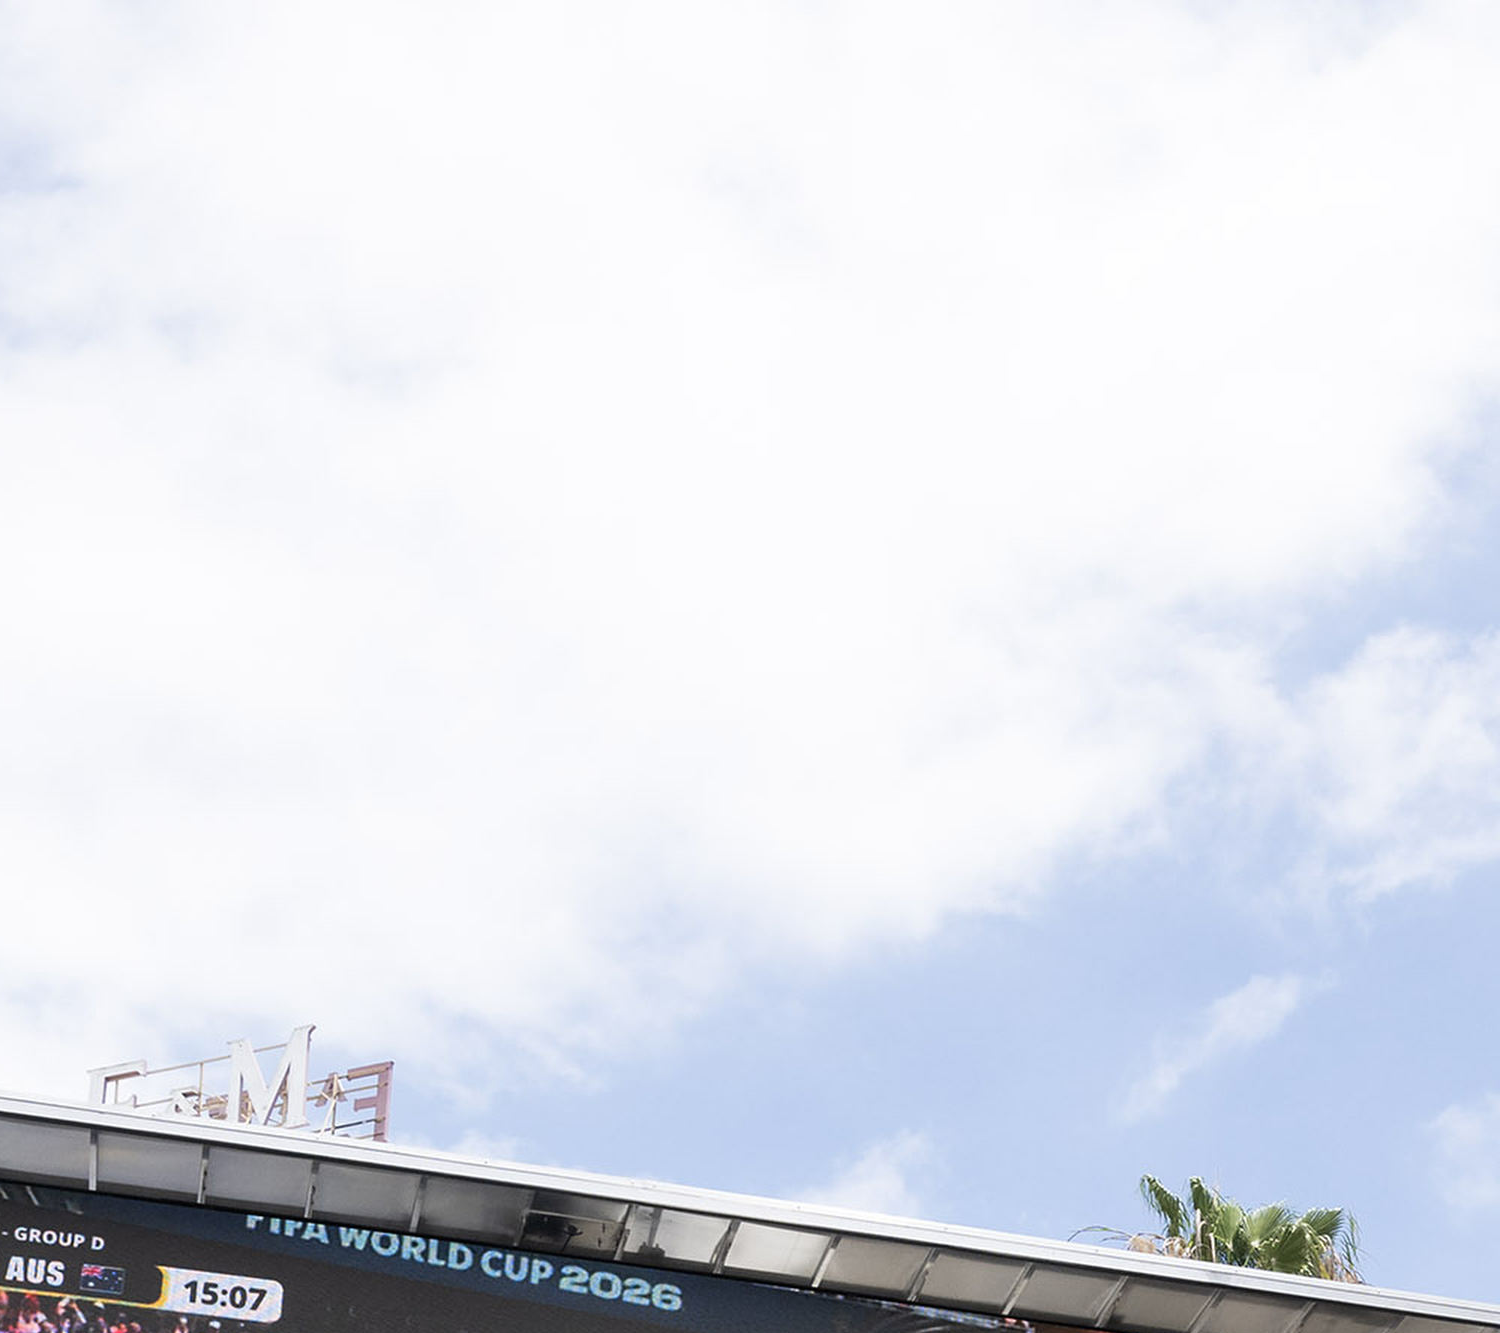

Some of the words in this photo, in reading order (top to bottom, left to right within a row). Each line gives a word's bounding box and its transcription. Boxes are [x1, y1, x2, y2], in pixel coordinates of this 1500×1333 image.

[14, 1227, 86, 1248] GROUP
[91, 1236, 106, 1251] D
[4, 1255, 66, 1287] AUS
[338, 1226, 474, 1271] WORLD
[480, 1250, 554, 1285] CUP
[558, 1265, 683, 1311] 2026
[184, 1279, 268, 1312] 15:07
